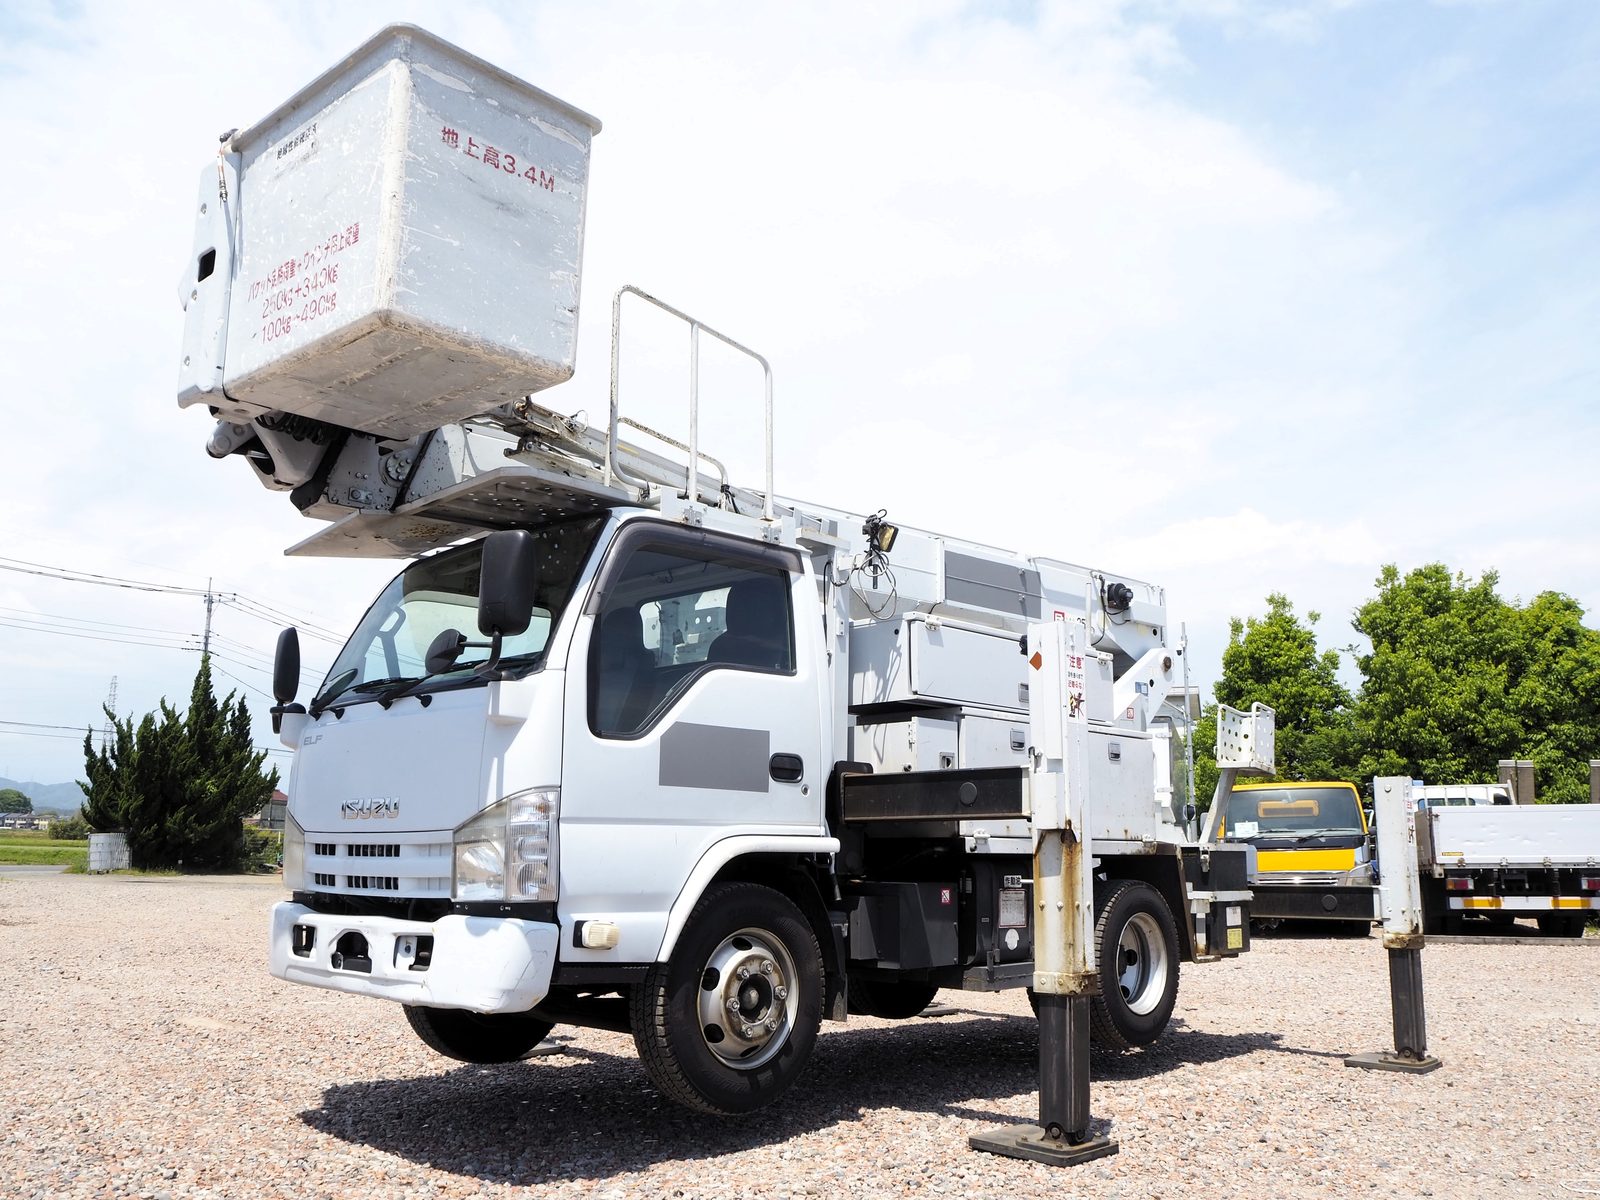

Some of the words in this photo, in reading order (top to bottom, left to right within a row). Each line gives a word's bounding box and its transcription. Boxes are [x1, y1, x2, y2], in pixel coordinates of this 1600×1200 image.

[441, 126, 554, 192] 地上高3.4M
[303, 734, 324, 746] ELF
[341, 796, 400, 820] ISUZU
